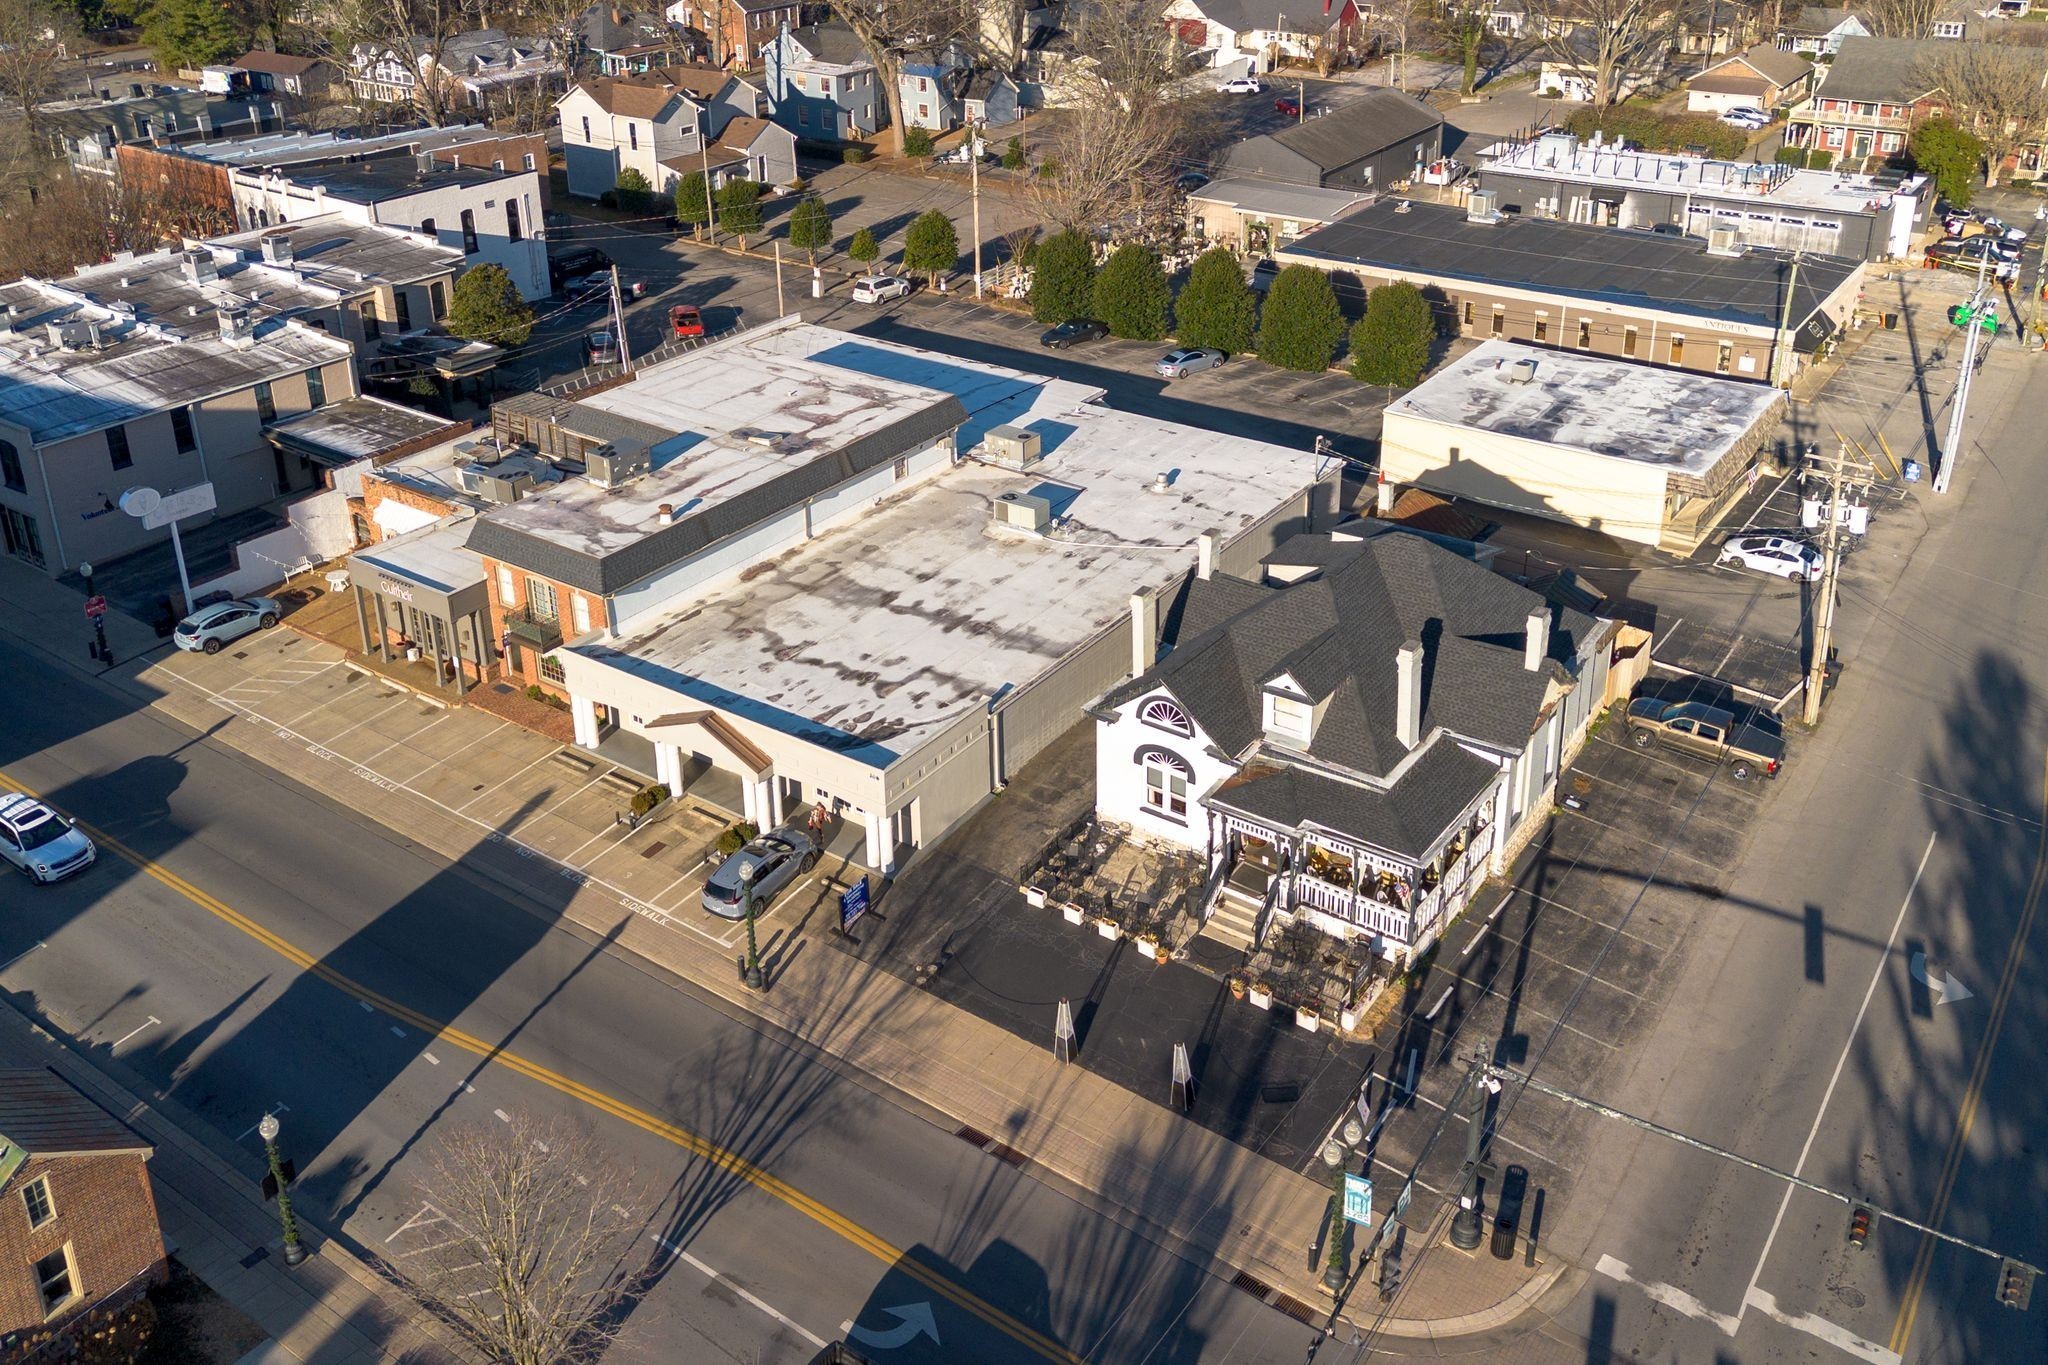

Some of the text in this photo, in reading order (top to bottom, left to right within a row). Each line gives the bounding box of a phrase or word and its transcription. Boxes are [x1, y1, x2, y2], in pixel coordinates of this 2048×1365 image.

[1704, 320, 1749, 333] ANTIQUES
[277, 730, 296, 741] NOT
[306, 745, 335, 761] BLOCK
[514, 847, 536, 859] NOT
[560, 868, 594, 889] BLOCK
[619, 898, 670, 926] SIDEWALK
